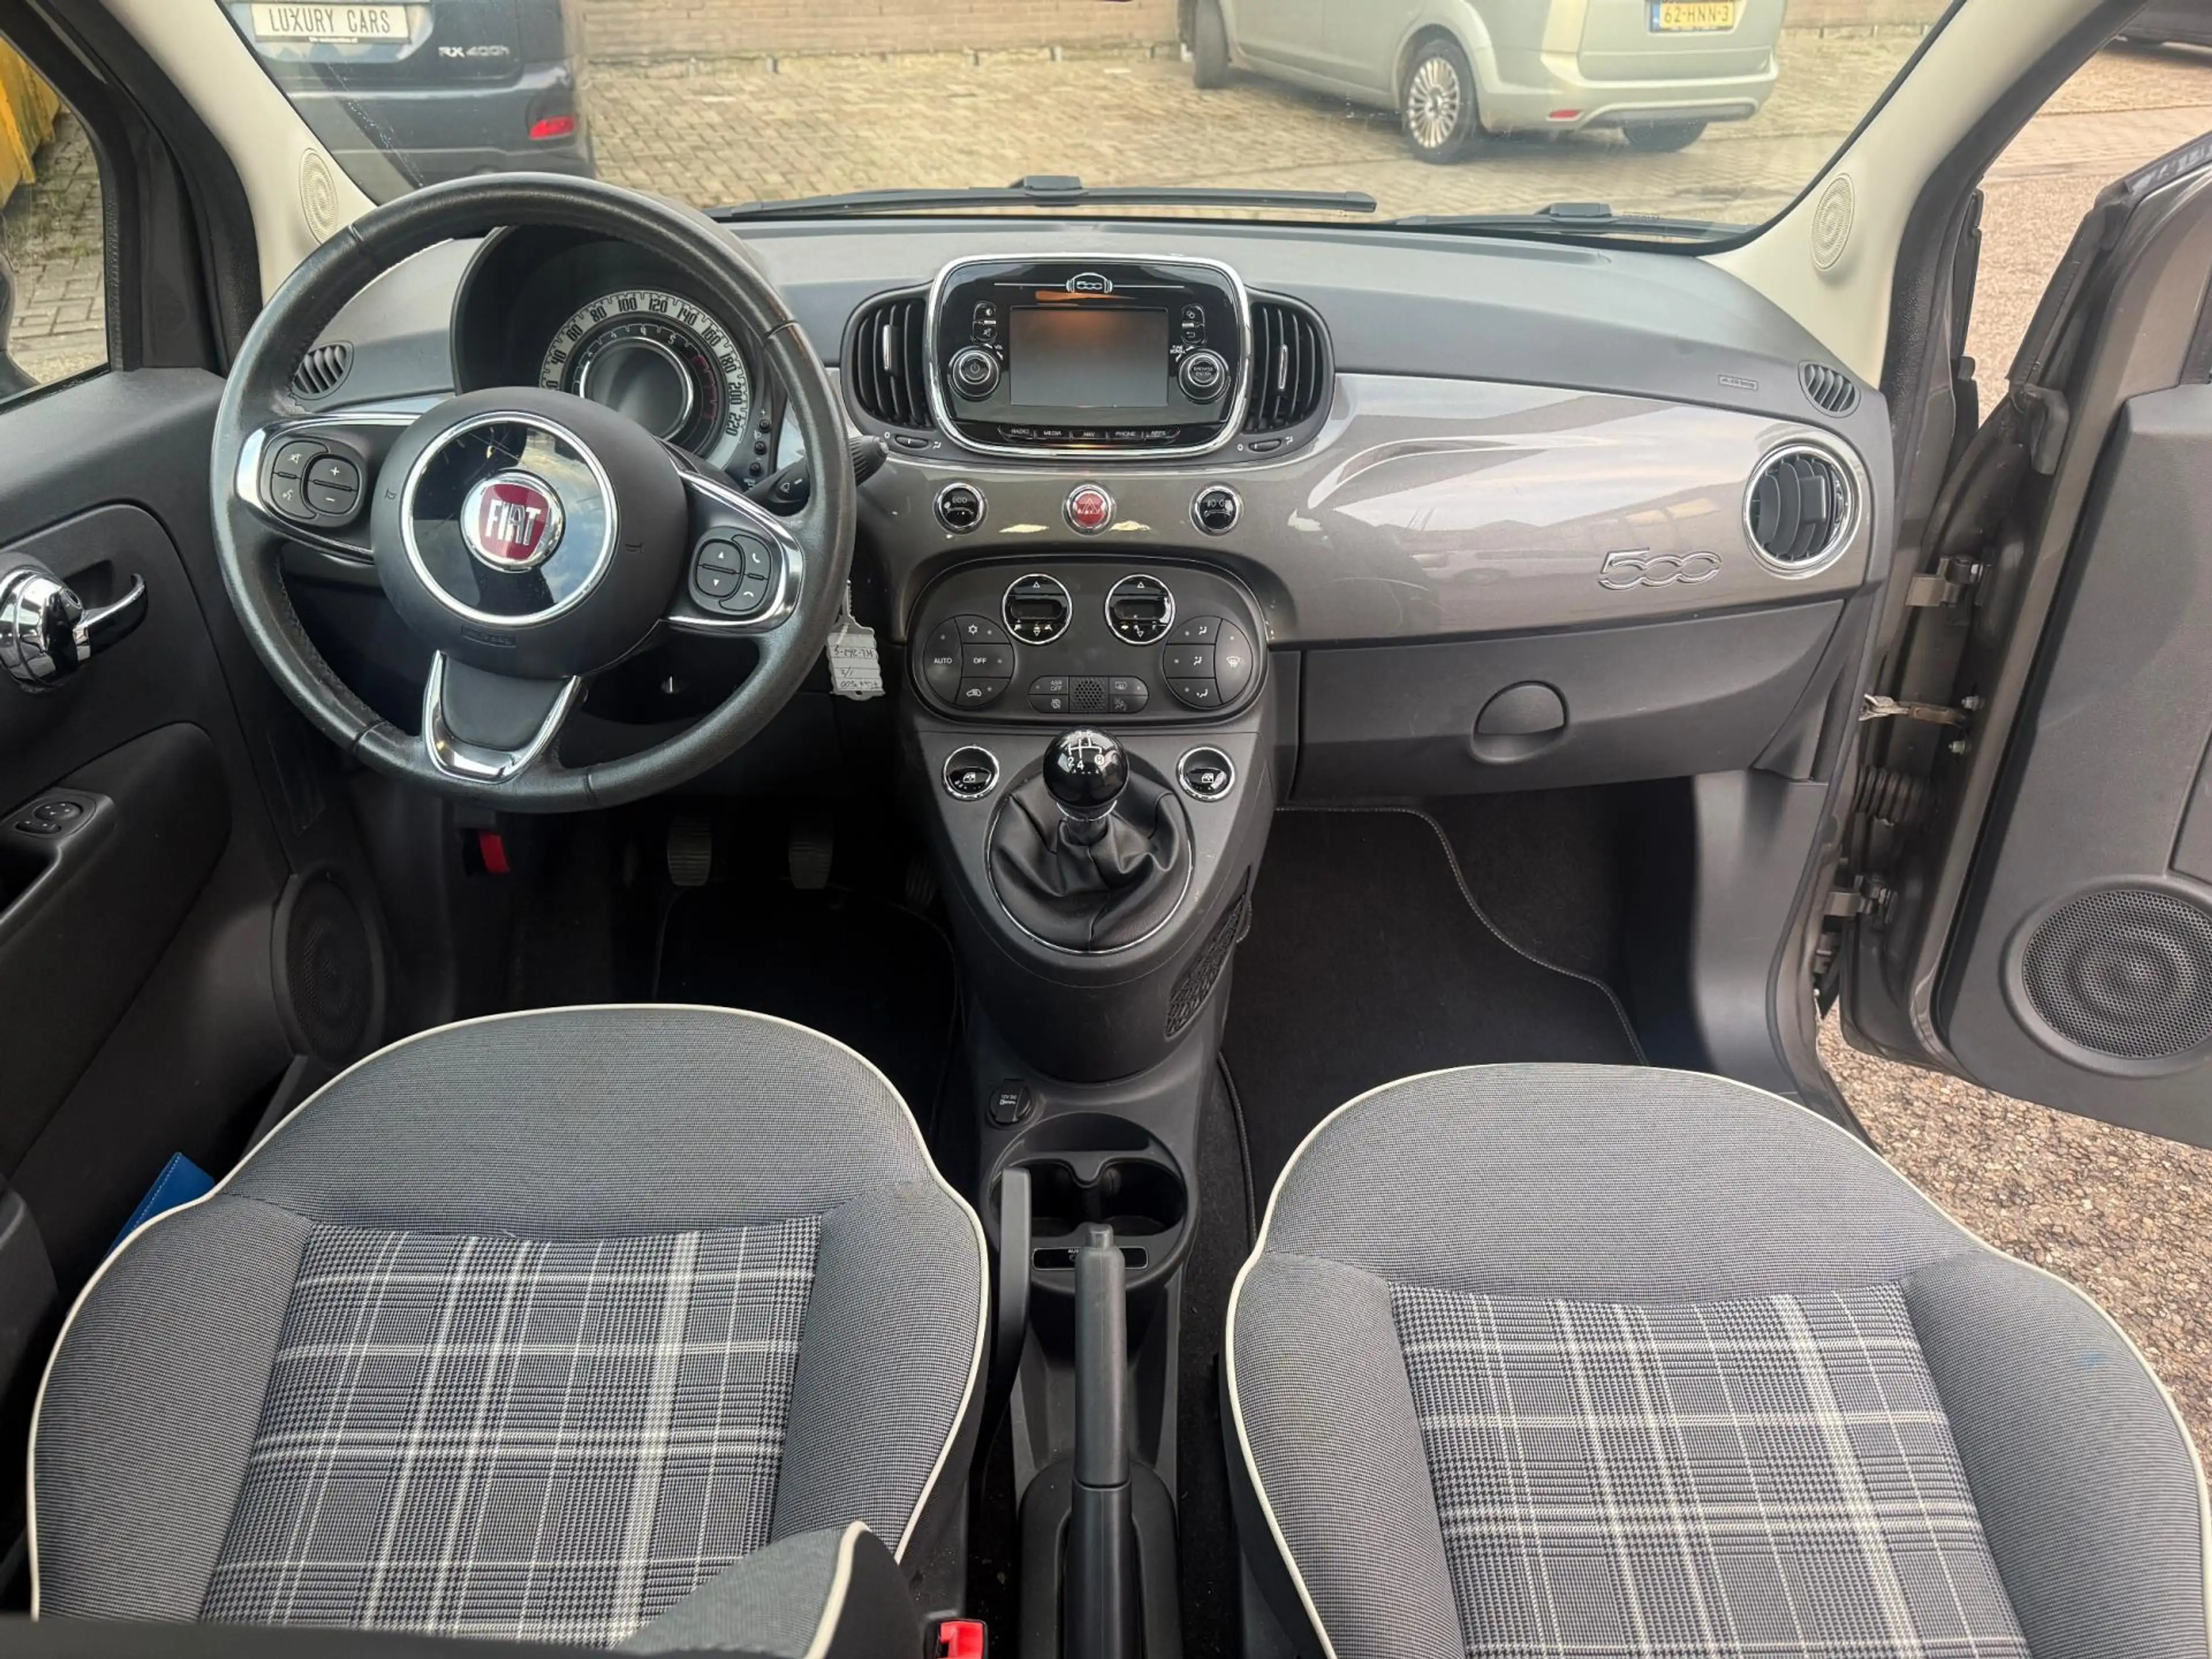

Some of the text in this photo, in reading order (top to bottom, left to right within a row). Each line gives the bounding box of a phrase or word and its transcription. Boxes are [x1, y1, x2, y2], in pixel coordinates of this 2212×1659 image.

[268, 8, 391, 33] LUXURY CARS
[438, 46, 465, 58] RX
[1077, 281, 1103, 290] 500
[618, 297, 638, 312] 100
[649, 297, 668, 313] 120
[590, 305, 607, 322] 80
[677, 308, 698, 325] 140
[566, 324, 584, 342] 60
[700, 325, 721, 346] 160
[551, 349, 566, 364] 40
[719, 353, 737, 373] 180
[728, 382, 743, 405] 200
[725, 412, 742, 436] 220
[485, 499, 541, 546] FIAT
[1597, 546, 1723, 591] 500
[1067, 756, 1075, 767] 2
[1077, 760, 1085, 770] 4
